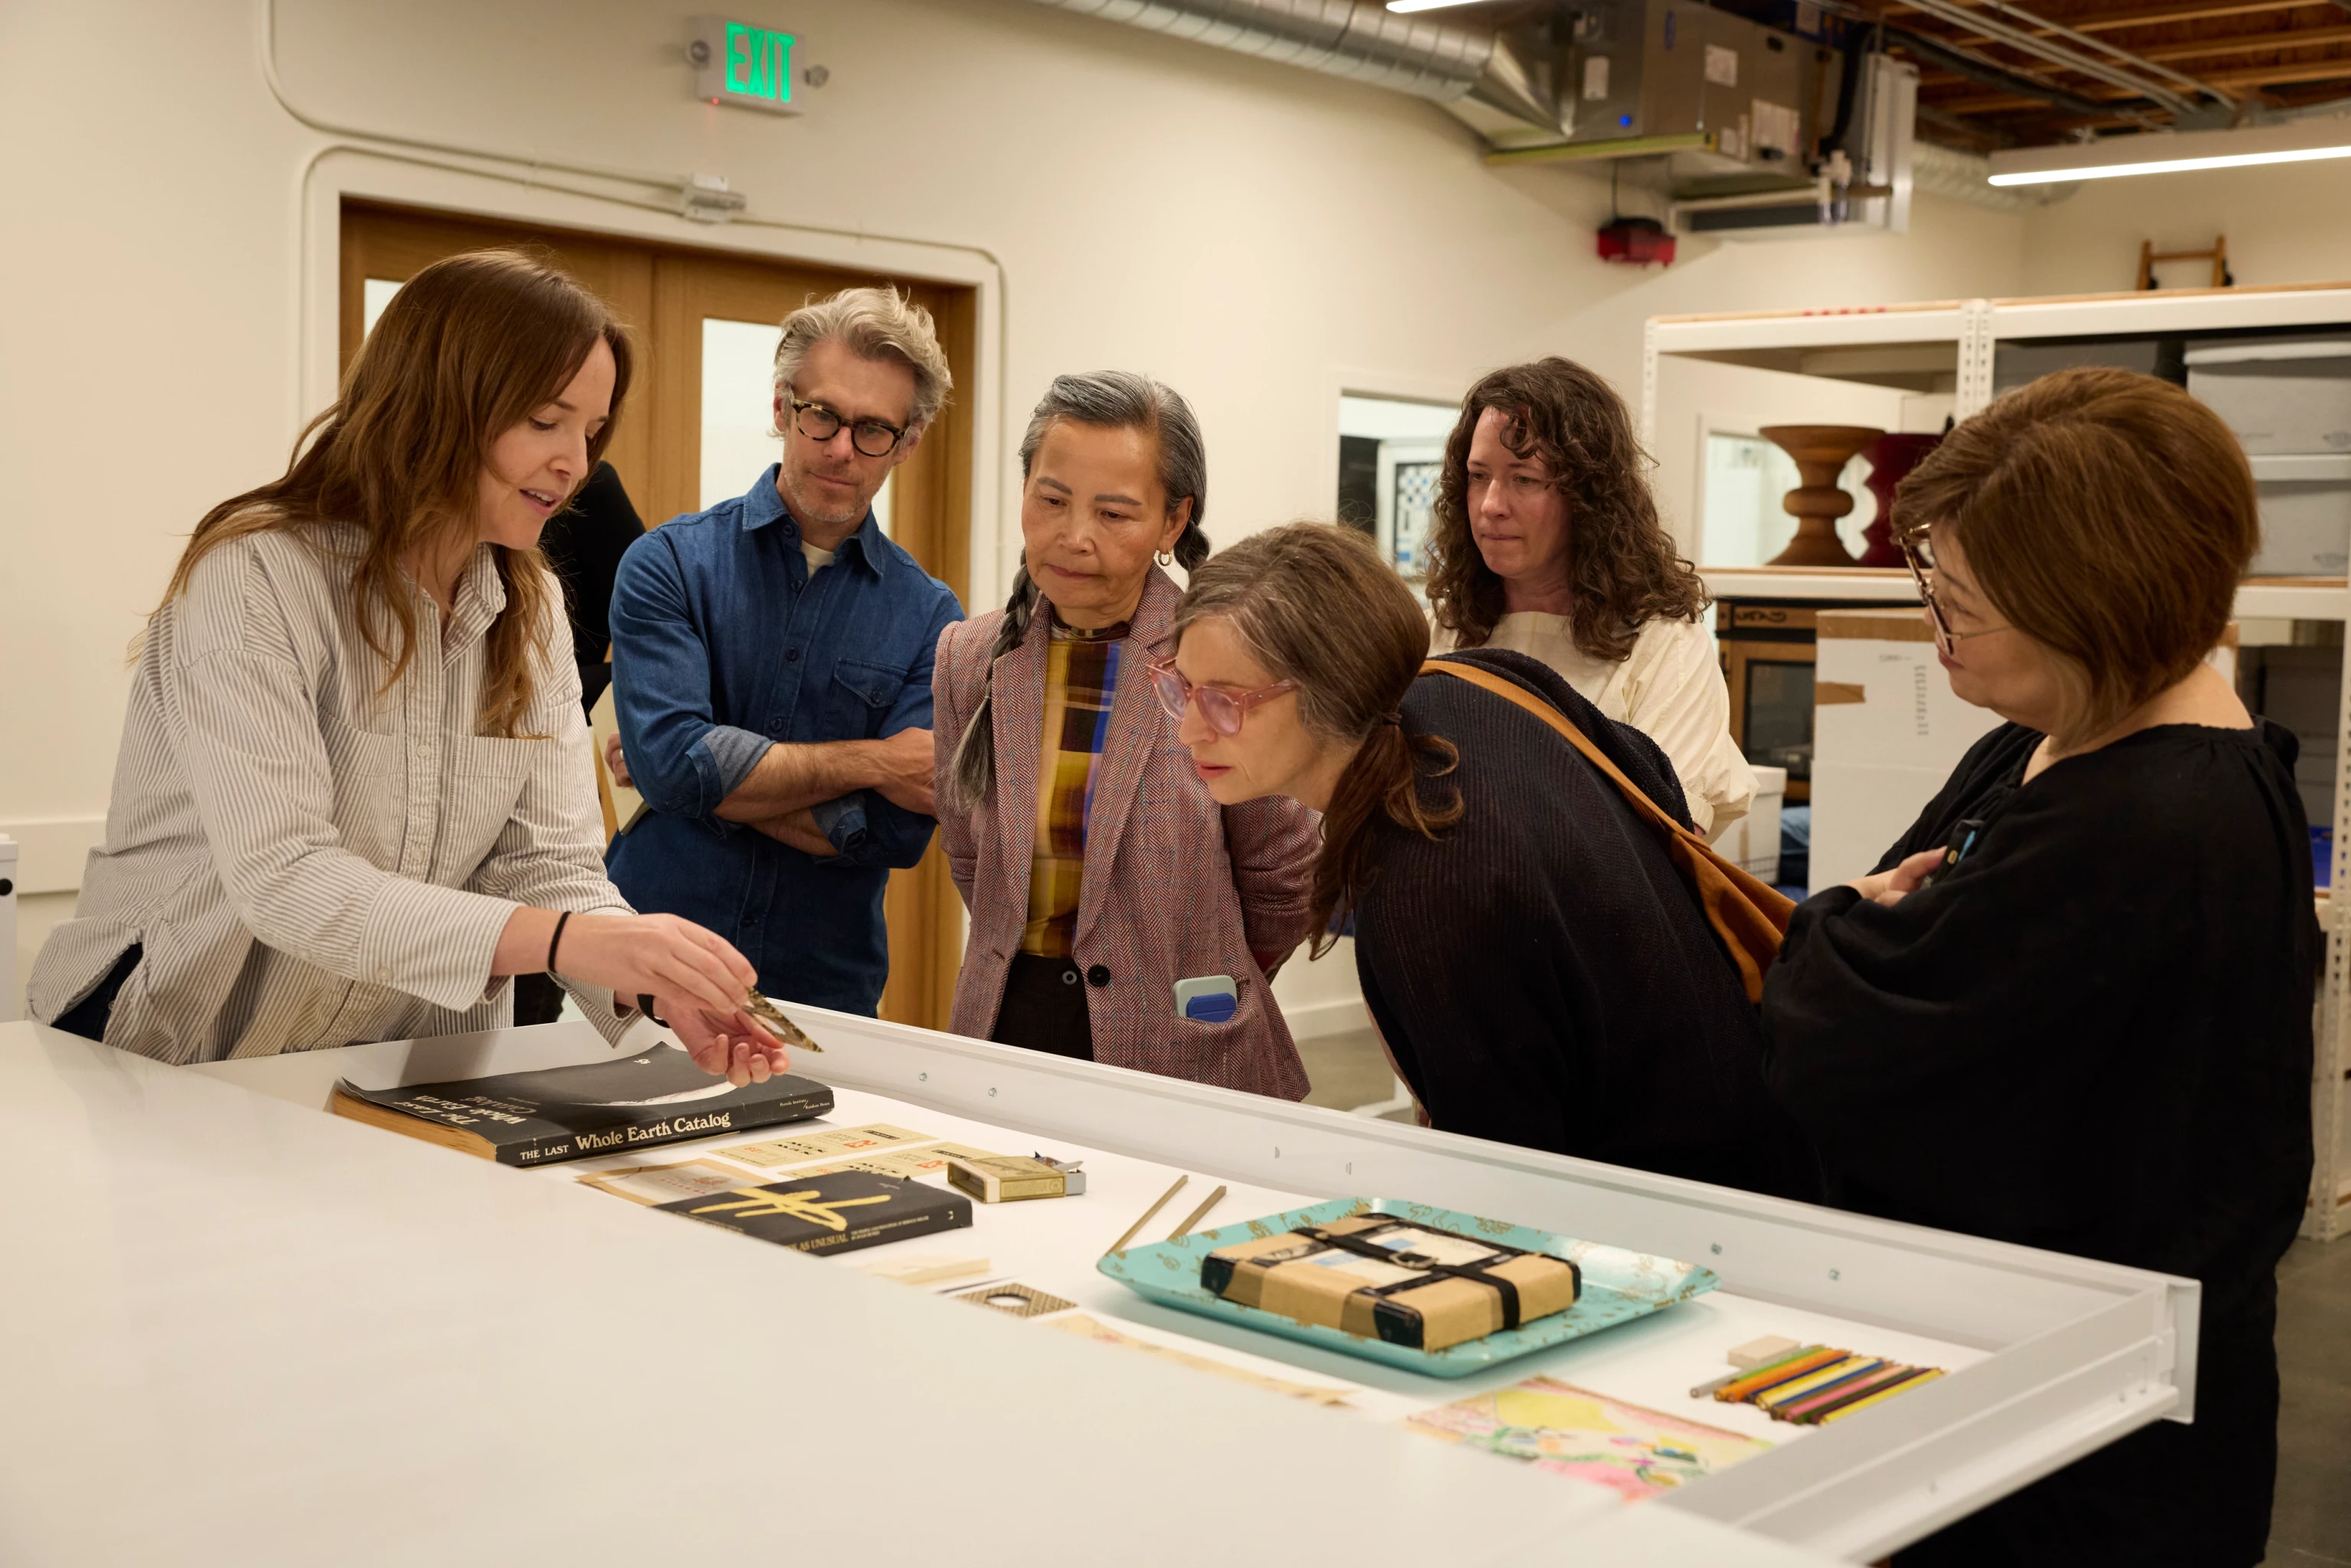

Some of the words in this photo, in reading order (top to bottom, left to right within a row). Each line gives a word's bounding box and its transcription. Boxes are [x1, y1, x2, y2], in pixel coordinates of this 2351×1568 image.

[726, 21, 794, 103] EXIT
[393, 1101, 443, 1113] Last
[412, 1095, 472, 1110] Earth
[460, 1096, 536, 1114] Catalog
[440, 1113, 480, 1125] The
[469, 1108, 527, 1125] Whole
[520, 1150, 540, 1161] THE
[545, 1145, 569, 1156] LAST
[575, 1130, 624, 1151] Whole
[628, 1117, 672, 1142] Earth
[674, 1112, 731, 1135] Catalog
[810, 1232, 849, 1250] UNUSUAL
